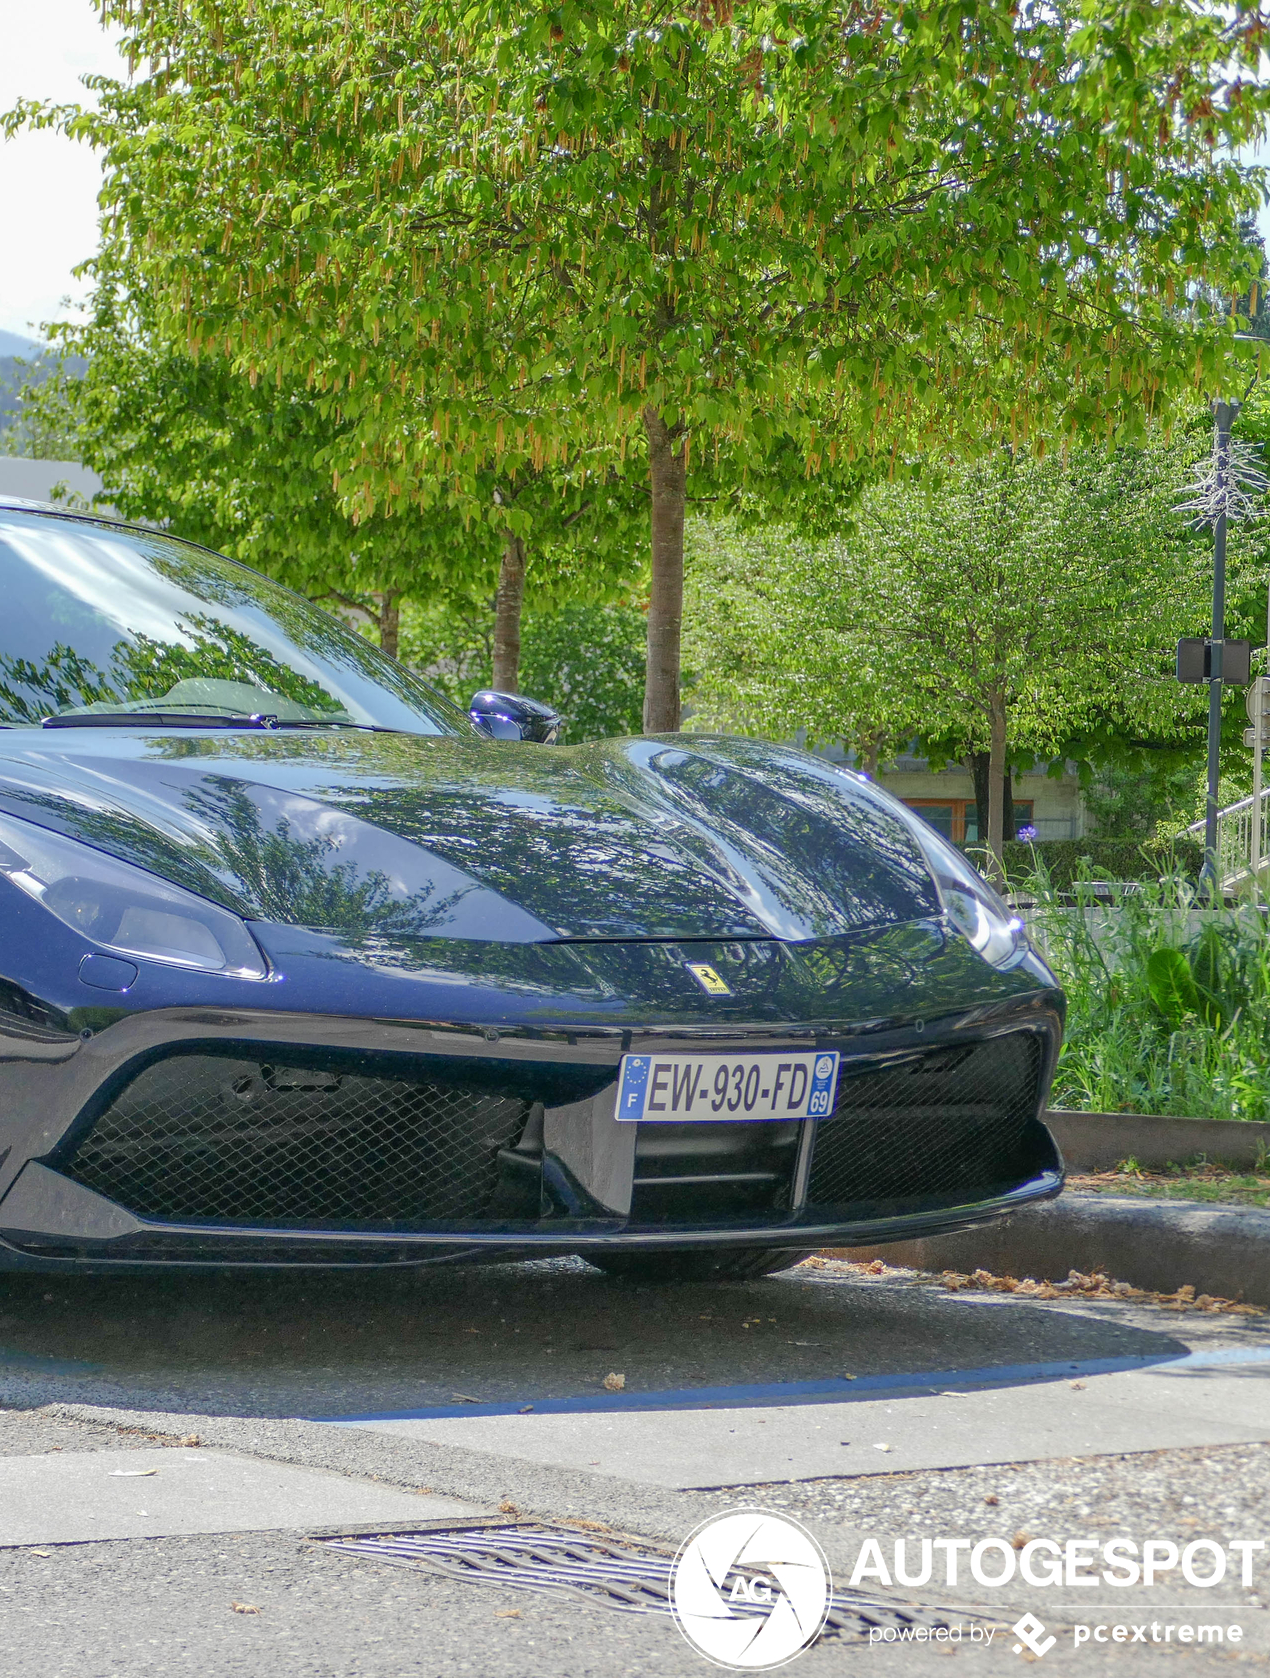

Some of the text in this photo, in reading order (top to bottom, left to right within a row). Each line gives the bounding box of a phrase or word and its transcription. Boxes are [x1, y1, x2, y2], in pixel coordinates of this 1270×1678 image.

[627, 1093, 637, 1108] F
[648, 1063, 809, 1112] EW-930-FD
[810, 1091, 828, 1113] 69
